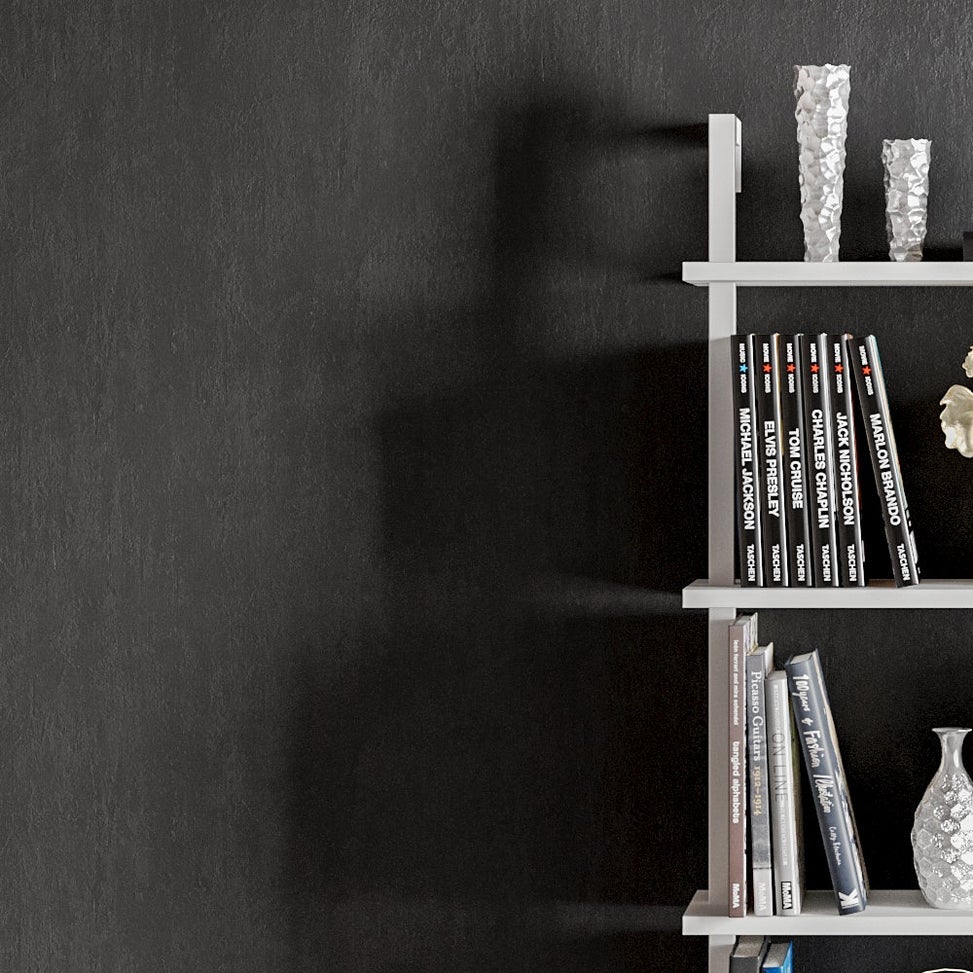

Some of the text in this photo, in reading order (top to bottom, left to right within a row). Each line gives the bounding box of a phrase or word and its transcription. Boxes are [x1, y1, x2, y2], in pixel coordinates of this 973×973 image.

[762, 343, 770, 363] MOVIE
[786, 343, 794, 363] MOVIE
[858, 345, 874, 396] MOVIE ICONS
[739, 407, 756, 530] MICHAEL JACKSON
[764, 420, 780, 518] ELVIS PRESLEY
[789, 428, 804, 509] TOM CRUISE
[811, 409, 829, 529] CHARLES CHAPLIN
[836, 411, 855, 526] JACK NICHOLSON
[869, 413, 901, 527] MARLON BRANDO
[746, 543, 756, 582] TASCHEN
[771, 543, 781, 582] TASCHEN
[796, 543, 806, 582] TASCHEN
[821, 543, 831, 582] TASCHEN
[847, 543, 857, 582] TASCHEN
[897, 543, 911, 581] TASCHEN
[751, 670, 763, 714] Picasso
[792, 691, 811, 712] years
[793, 674, 810, 691] 100
[753, 715, 765, 762] Guitars
[772, 733, 786, 756] ON
[803, 730, 825, 768] Fashion
[730, 740, 741, 824] tangled alphabets
[773, 764, 789, 802] LINE
[813, 774, 834, 814] Illustration
[732, 883, 741, 909] MoMA
[758, 882, 768, 911] MoMA
[781, 882, 792, 910] MoMA
[838, 888, 859, 910] K
